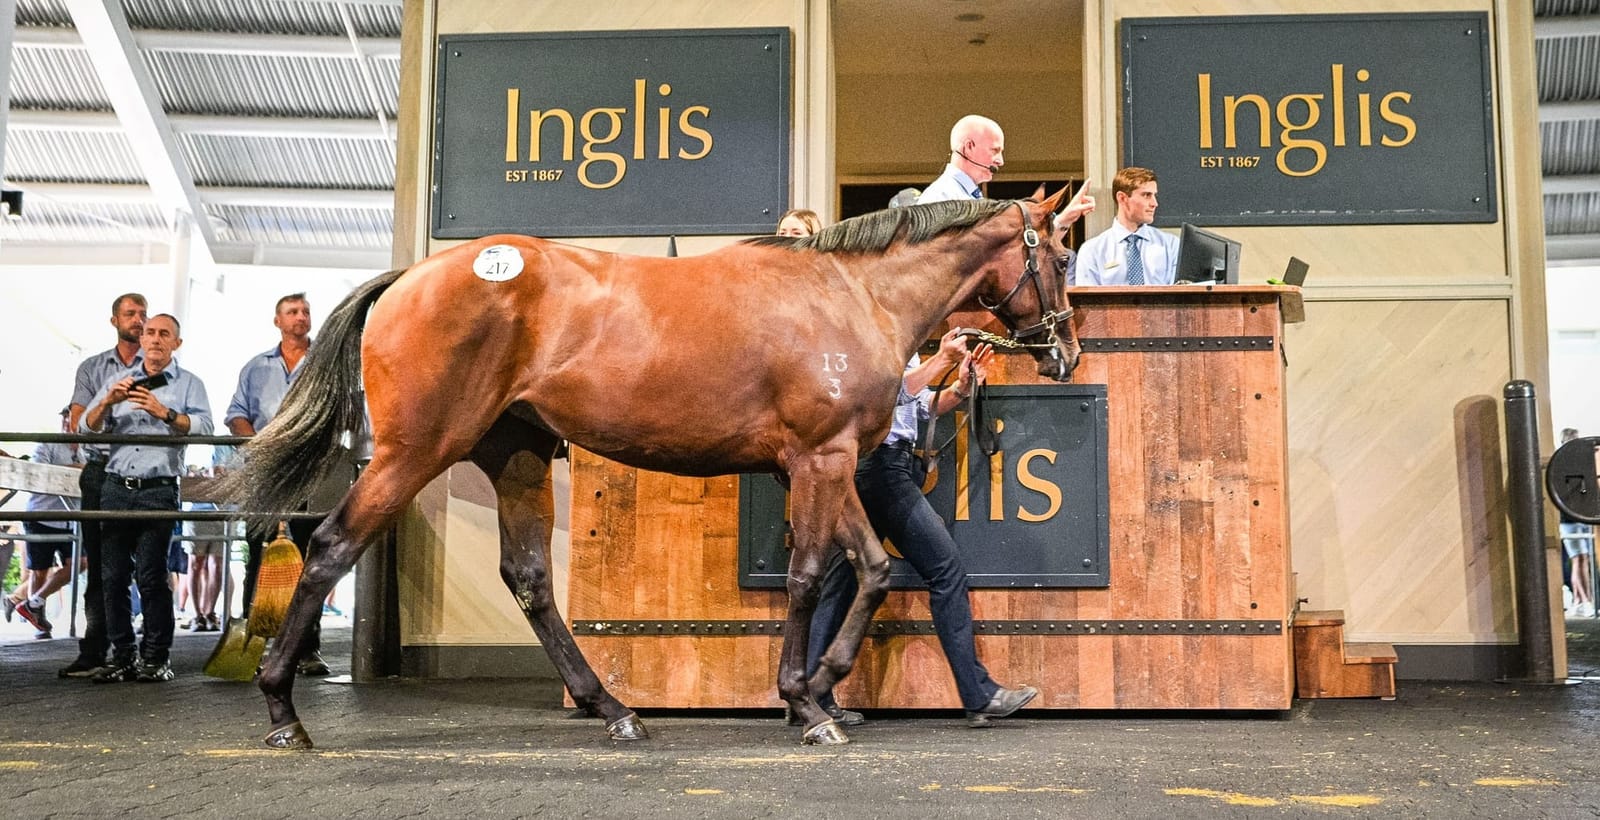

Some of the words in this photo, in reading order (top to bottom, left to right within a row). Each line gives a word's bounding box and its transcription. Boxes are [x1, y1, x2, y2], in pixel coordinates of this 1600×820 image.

[1197, 63, 1417, 178] Inglis
[505, 78, 713, 189] Inglis
[1200, 156, 1224, 168] EST
[1228, 156, 1261, 168] 1867
[505, 170, 528, 182] EST
[532, 169, 564, 182] 1867
[485, 262, 510, 275] 217
[822, 352, 848, 373] 13
[828, 377, 842, 400] 3
